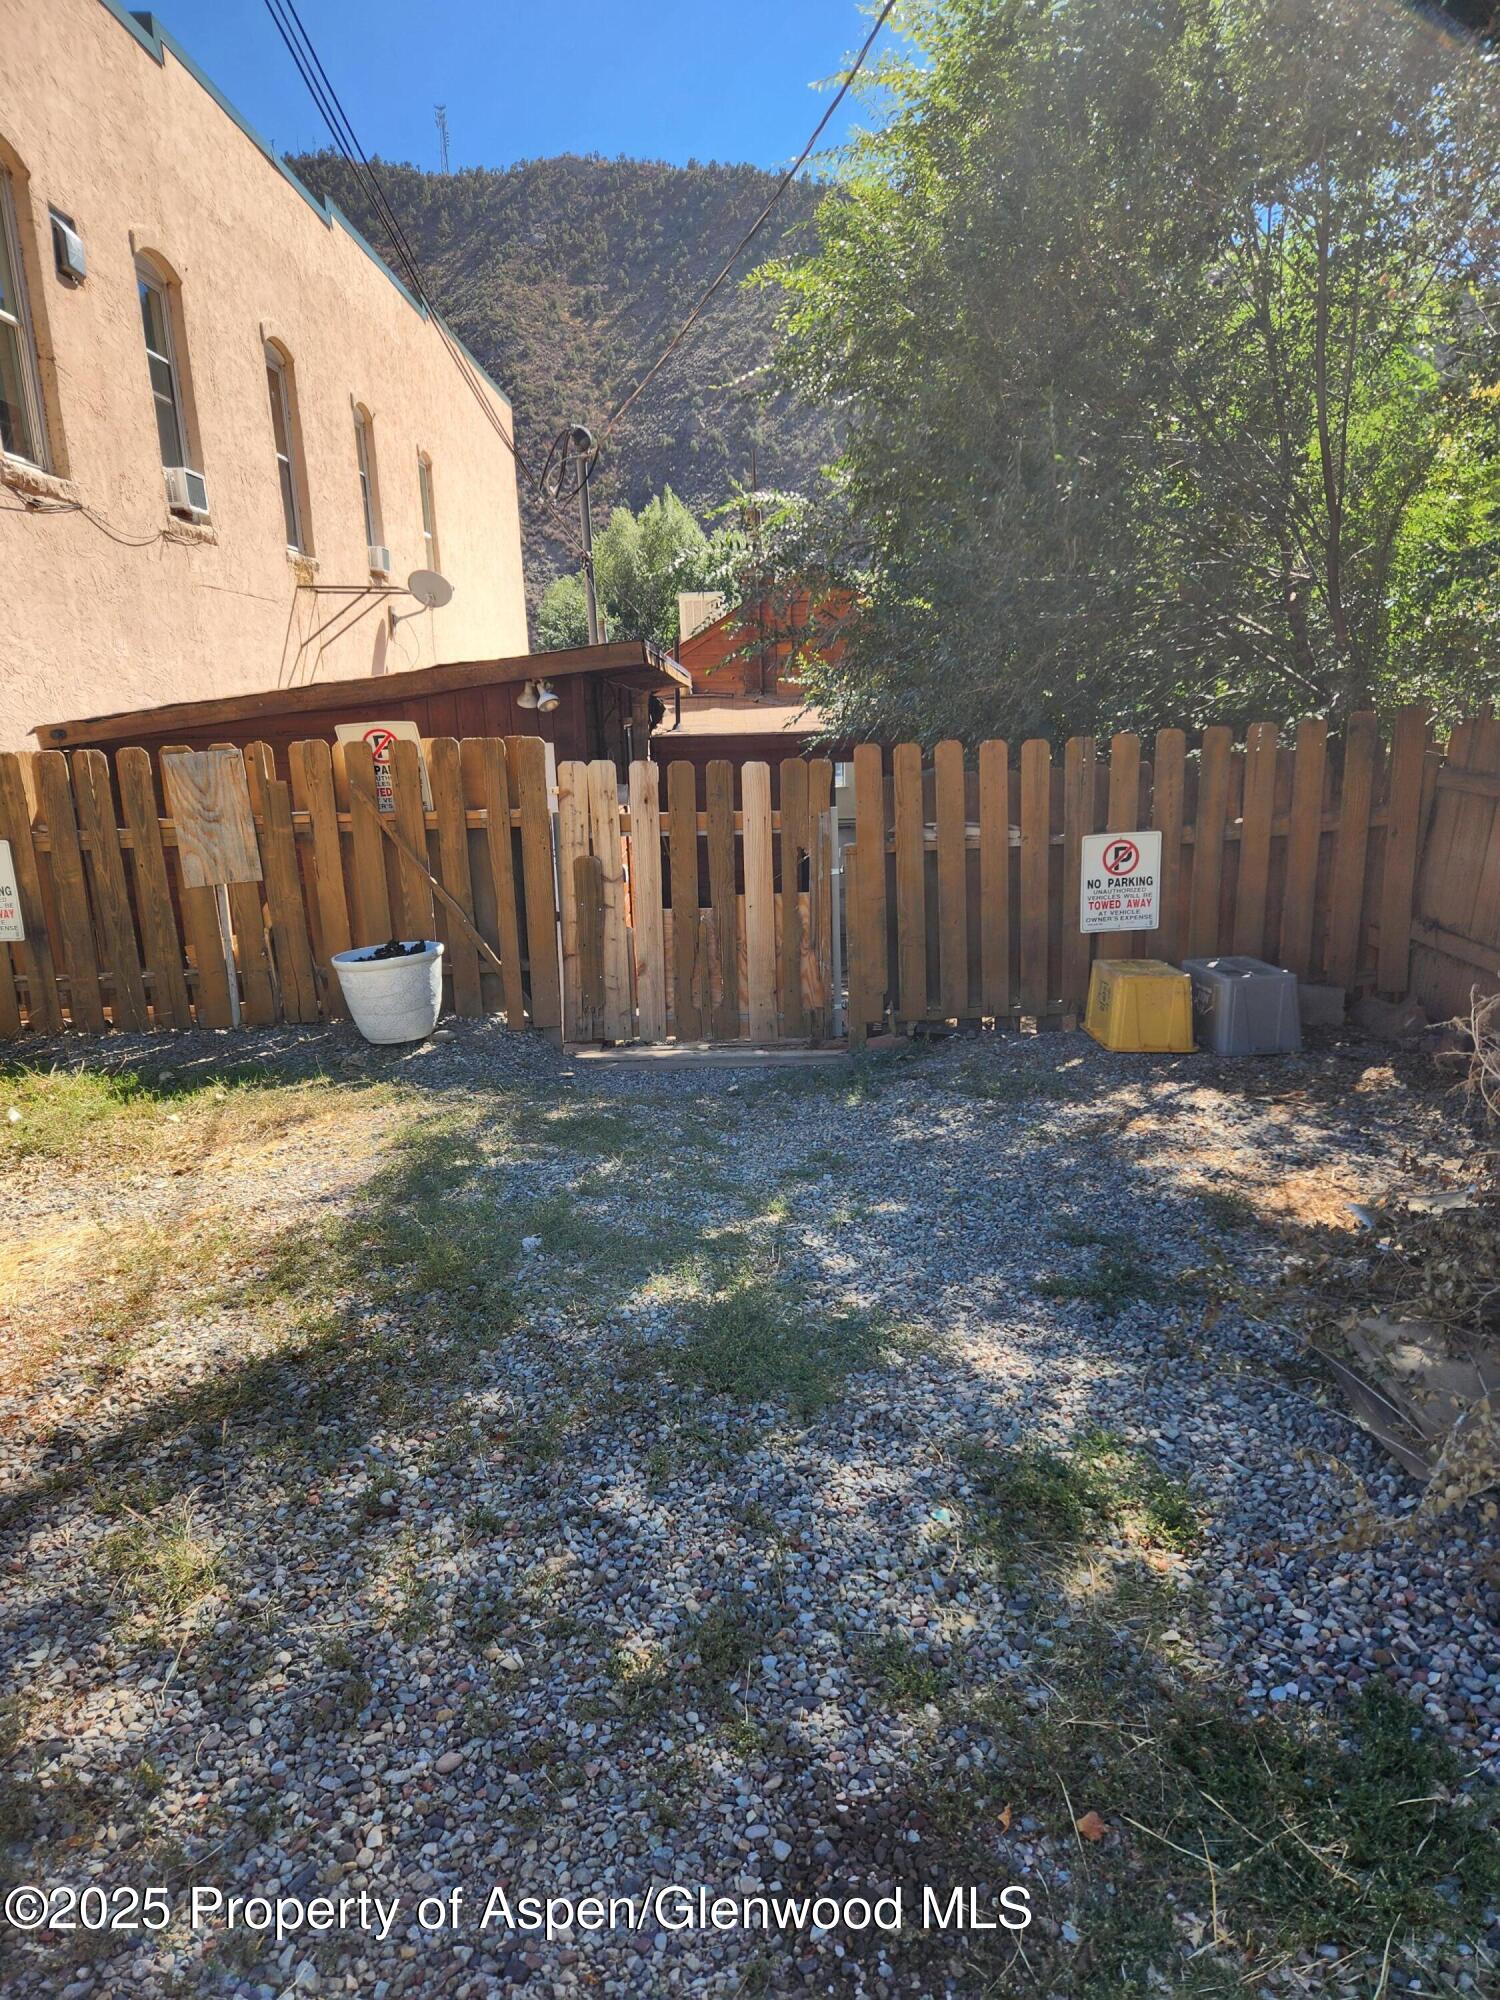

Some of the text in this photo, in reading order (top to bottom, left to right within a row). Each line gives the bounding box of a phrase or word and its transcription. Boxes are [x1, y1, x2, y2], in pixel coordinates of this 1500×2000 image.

[1087, 876, 1153, 889] NO PARKING
[1093, 887, 1147, 895] UNAUTHORIZED
[1088, 898, 1152, 910] TOWED AWAY
